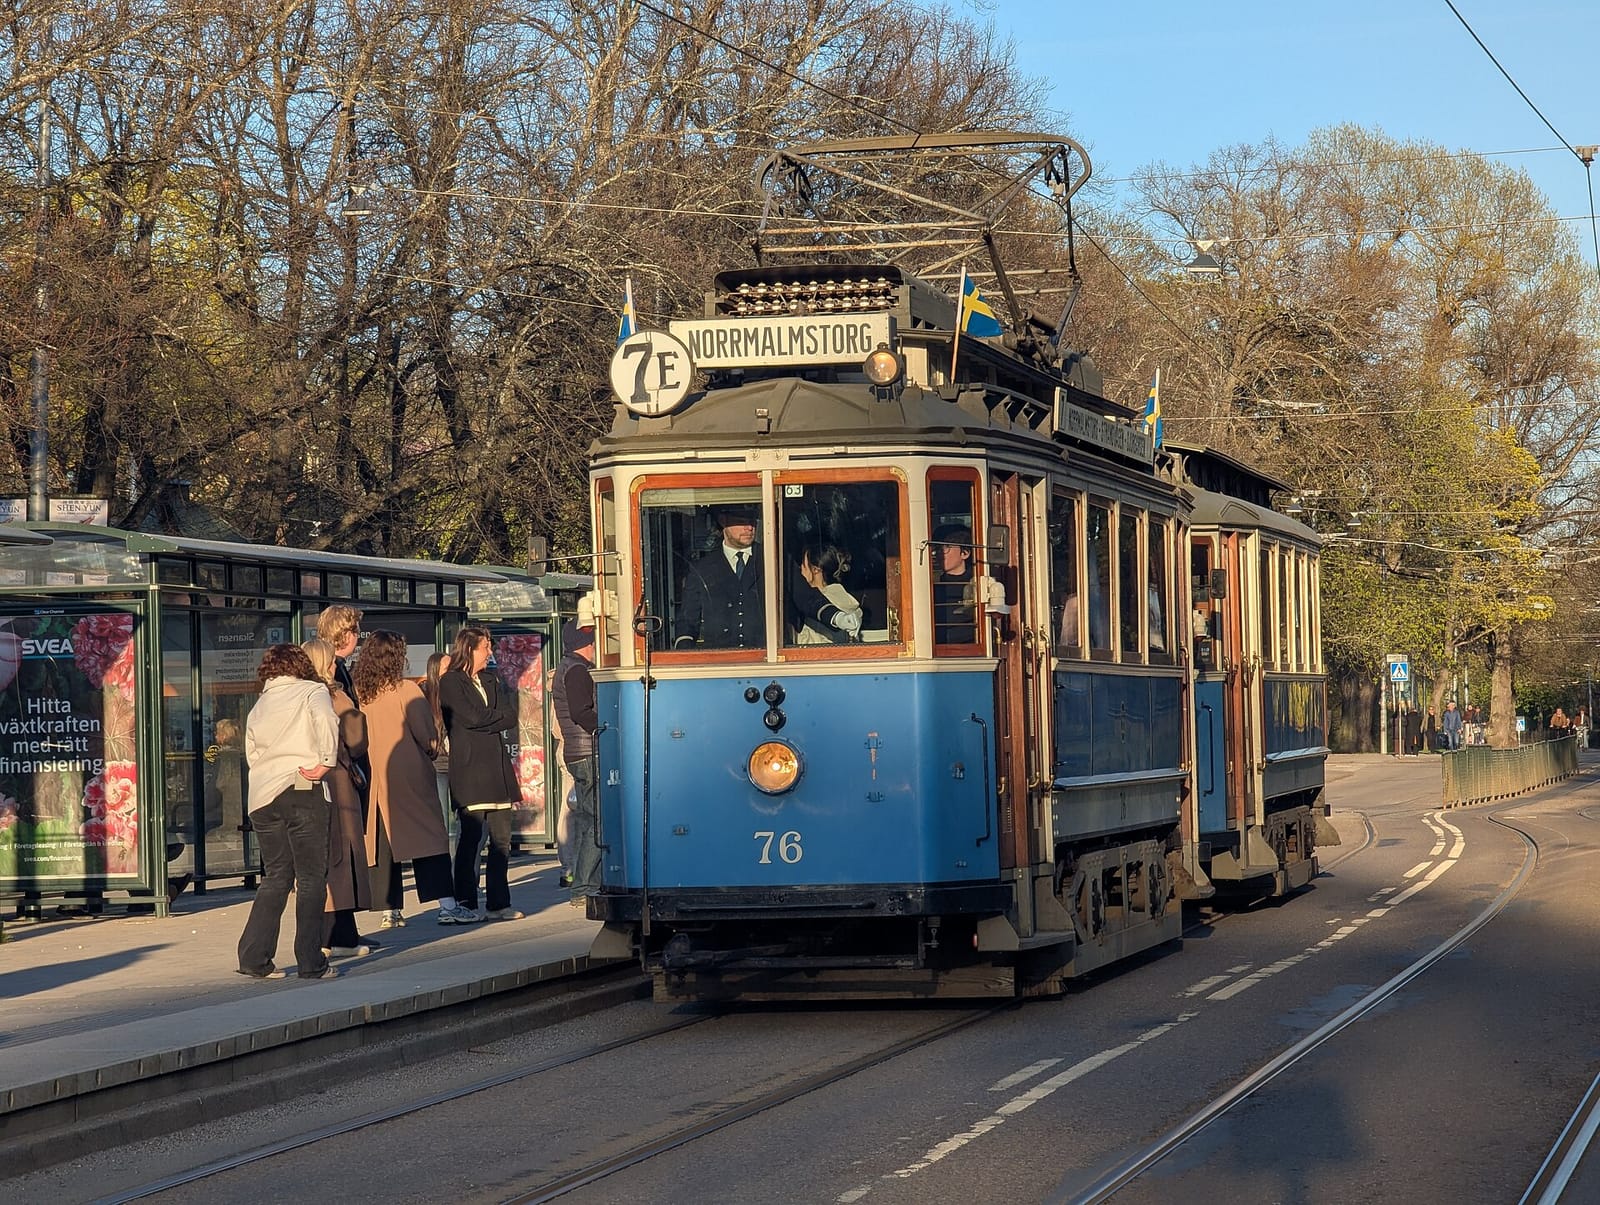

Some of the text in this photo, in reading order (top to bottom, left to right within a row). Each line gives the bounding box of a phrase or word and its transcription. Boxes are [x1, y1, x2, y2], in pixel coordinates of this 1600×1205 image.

[688, 323, 872, 359] NORRMALMSTORG
[56, 504, 101, 512] SHEN YUN
[21, 638, 74, 655] SVEA
[27, 698, 71, 714] Hitta
[0, 715, 100, 734] växtkraften
[13, 736, 89, 754] med rätt
[0, 756, 104, 775] finansiering
[753, 830, 803, 864] 76
